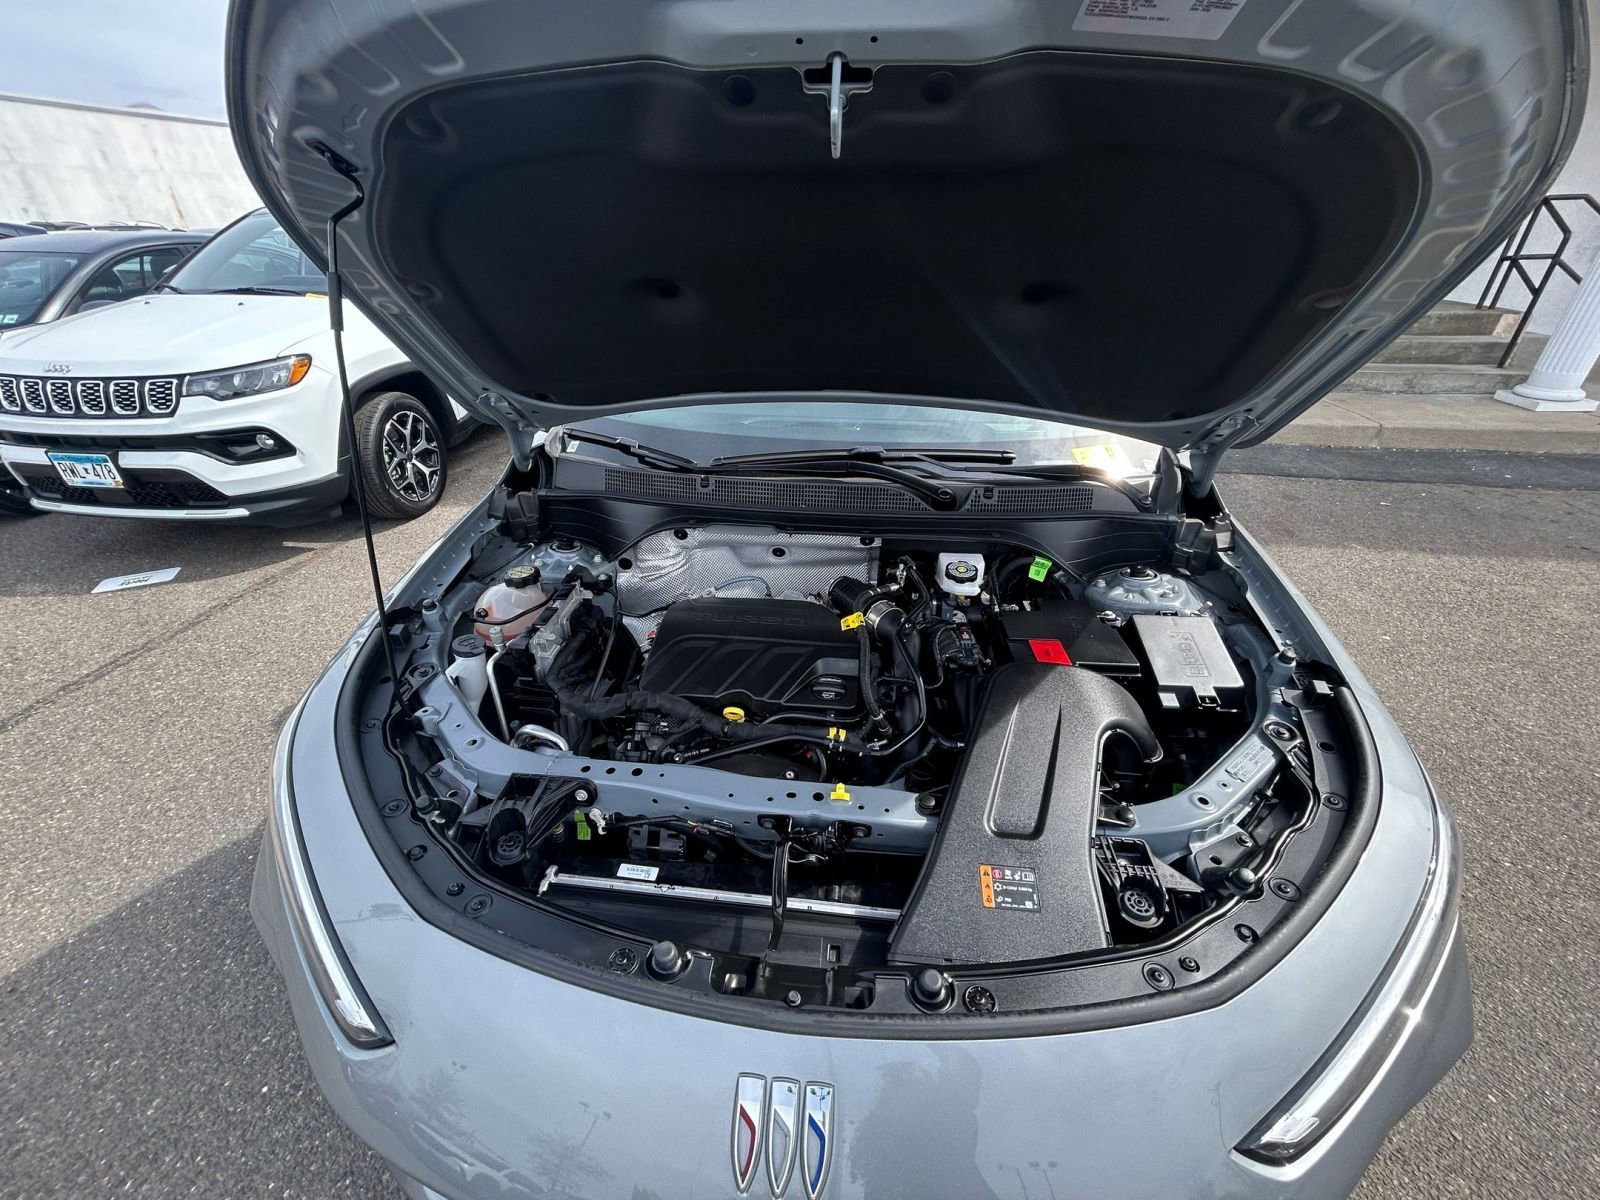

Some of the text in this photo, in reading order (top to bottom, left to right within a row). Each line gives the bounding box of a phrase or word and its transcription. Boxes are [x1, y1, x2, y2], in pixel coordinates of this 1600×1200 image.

[44, 362, 74, 374] Jeep
[91, 463, 117, 480] 478
[690, 612, 806, 627] TURBO
